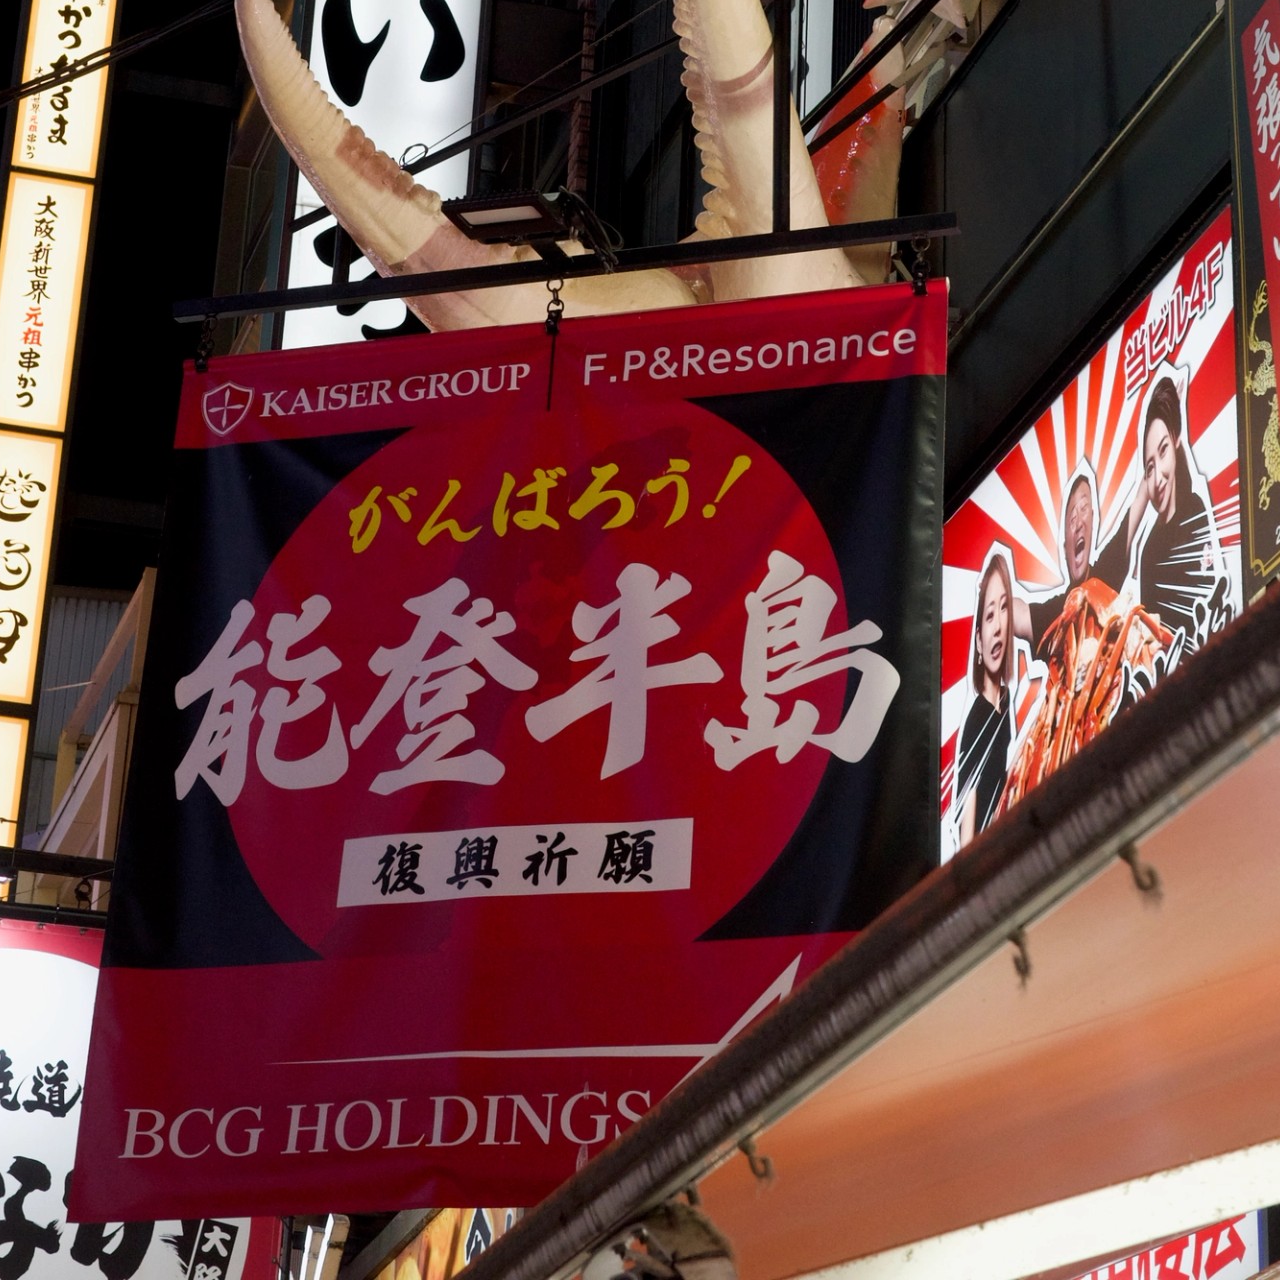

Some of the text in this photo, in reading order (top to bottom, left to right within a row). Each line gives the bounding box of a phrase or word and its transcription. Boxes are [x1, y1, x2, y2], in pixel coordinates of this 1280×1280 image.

[15, 195, 60, 408] 大阪新世界元祖串かつ
[1125, 241, 1225, 400] 当ビル4F
[259, 362, 531, 419] KAISER GROUP
[583, 324, 918, 387] F.P&Resonance
[348, 453, 753, 555] がんばろう!
[173, 549, 902, 807] 能登半島
[371, 828, 655, 898] 復興祈願
[118, 1088, 653, 1159] BCG HOLDINGS
